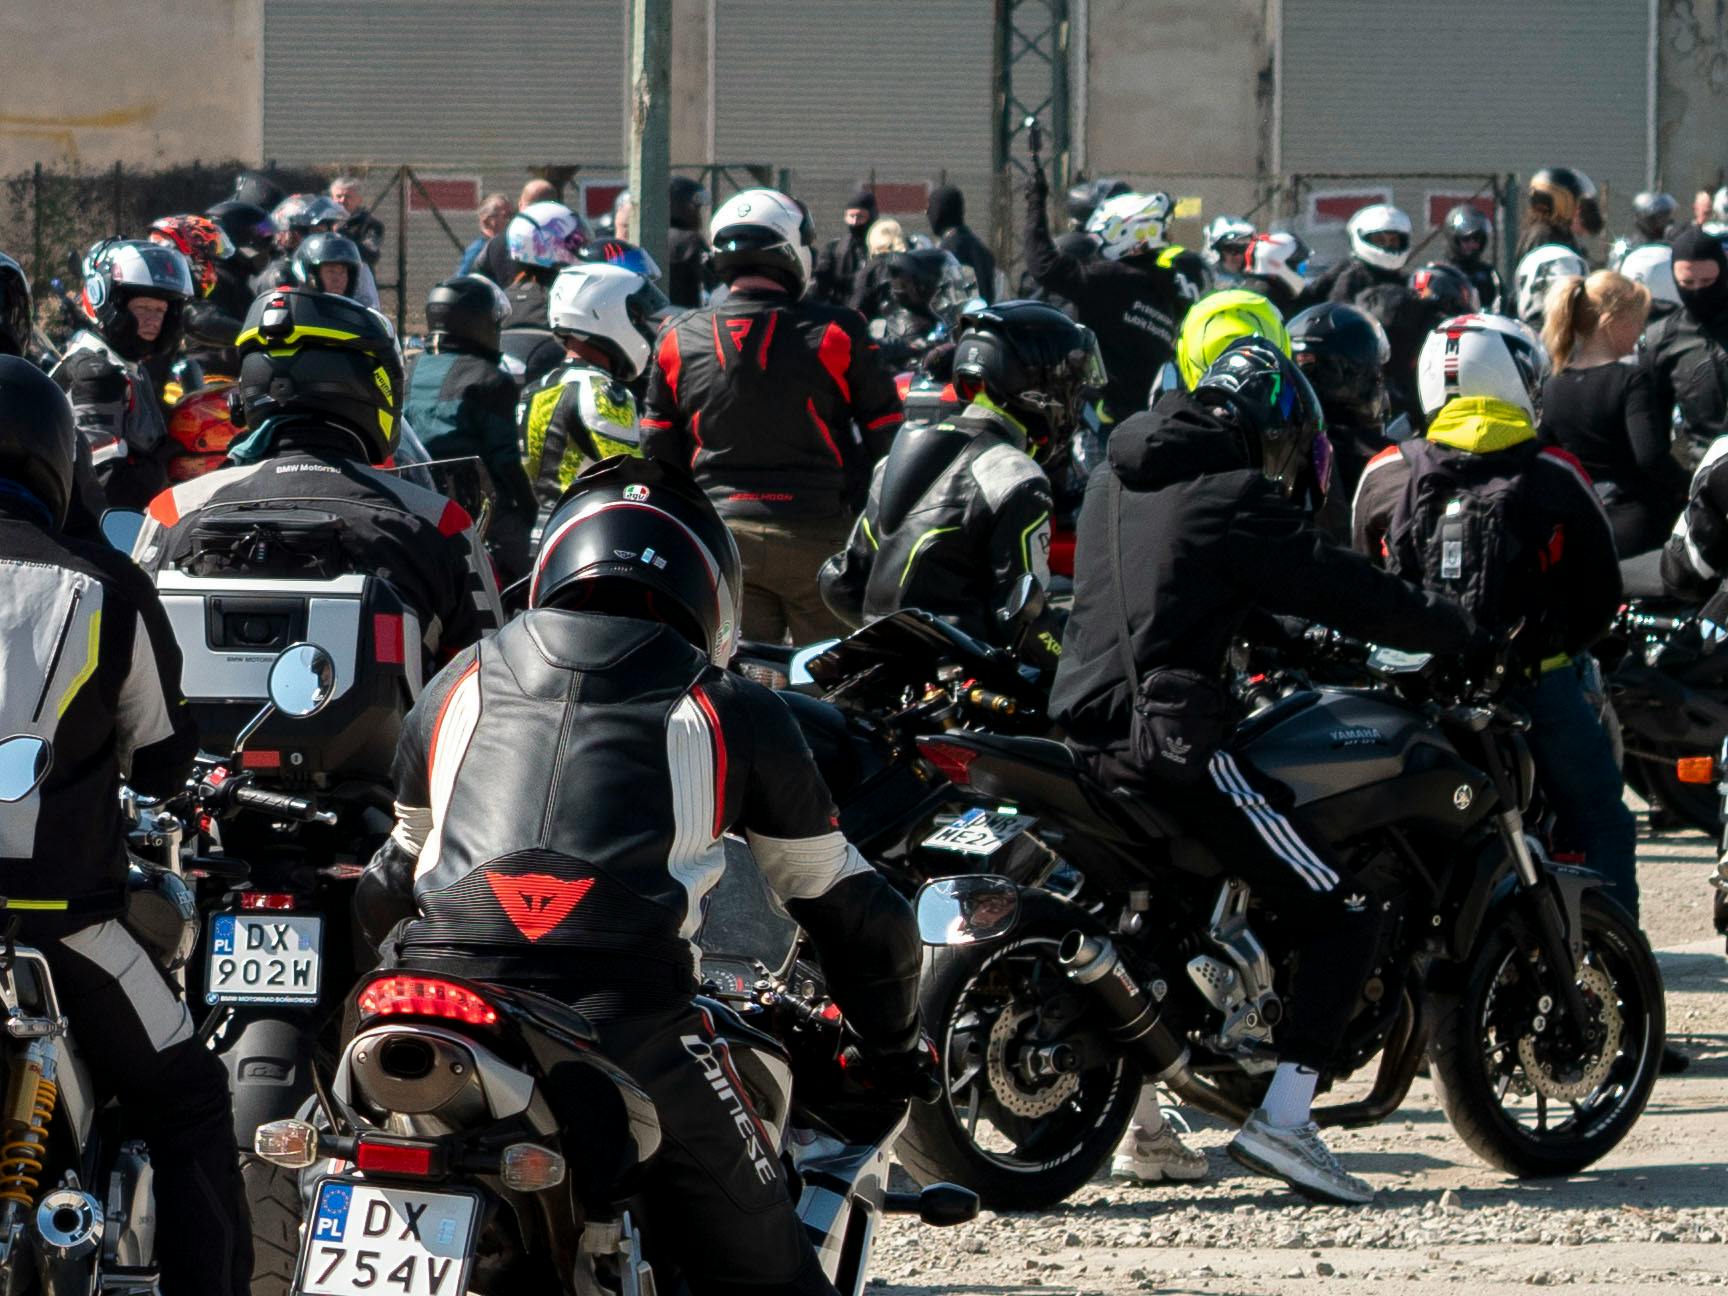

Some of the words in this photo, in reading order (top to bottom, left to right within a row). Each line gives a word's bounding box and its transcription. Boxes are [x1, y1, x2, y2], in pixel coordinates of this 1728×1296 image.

[276, 464, 299, 474] BMW
[214, 939, 232, 952] PL
[246, 923, 290, 950] DX
[217, 958, 312, 986] 902W
[316, 1217, 342, 1237] PL
[362, 1198, 427, 1241] DX
[315, 1246, 453, 1296] 754V
